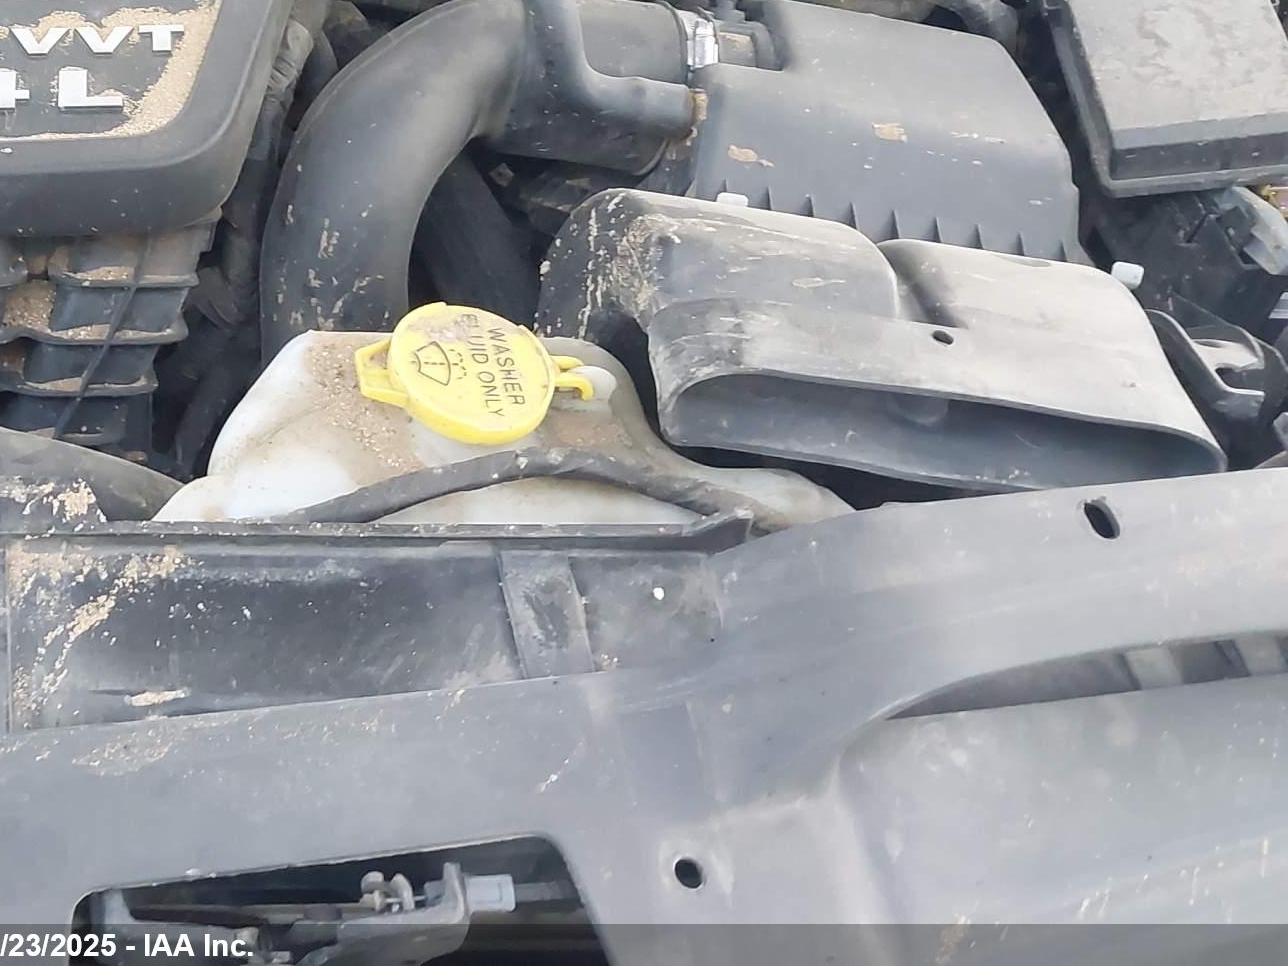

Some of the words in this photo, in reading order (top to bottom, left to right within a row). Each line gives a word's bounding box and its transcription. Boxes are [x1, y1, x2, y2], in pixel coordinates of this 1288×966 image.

[9, 24, 185, 56] VVT
[56, 67, 124, 109] L
[486, 326, 526, 406] WASHER
[478, 371, 505, 418] ONLY
